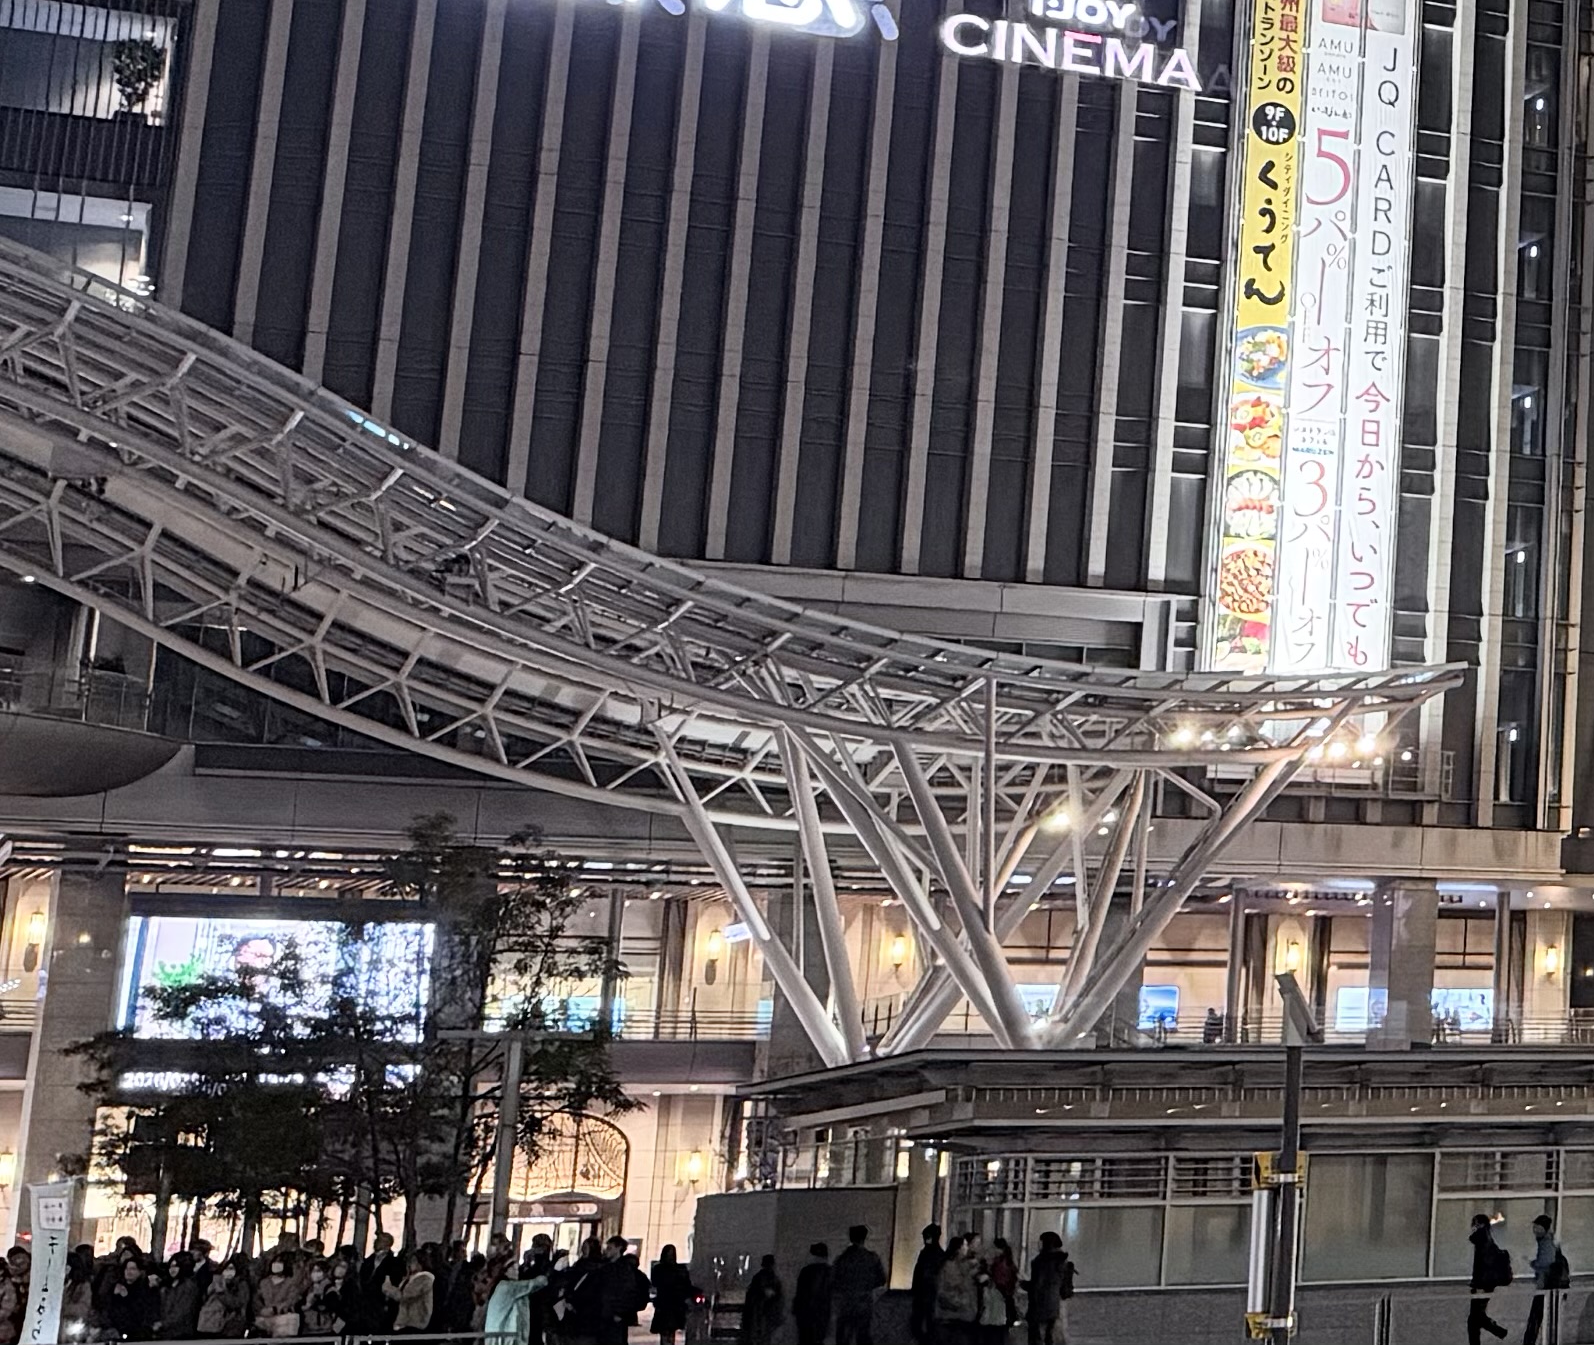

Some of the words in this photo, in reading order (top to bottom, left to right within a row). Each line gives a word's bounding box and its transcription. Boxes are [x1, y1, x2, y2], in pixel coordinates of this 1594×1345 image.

[940, 12, 1203, 92] CINEMA
[1317, 37, 1354, 54] AMU
[1317, 62, 1352, 79] AMU
[1264, 106, 1286, 121] 9F
[1260, 124, 1290, 142] 10F
[1243, 159, 1286, 307] くうてん
